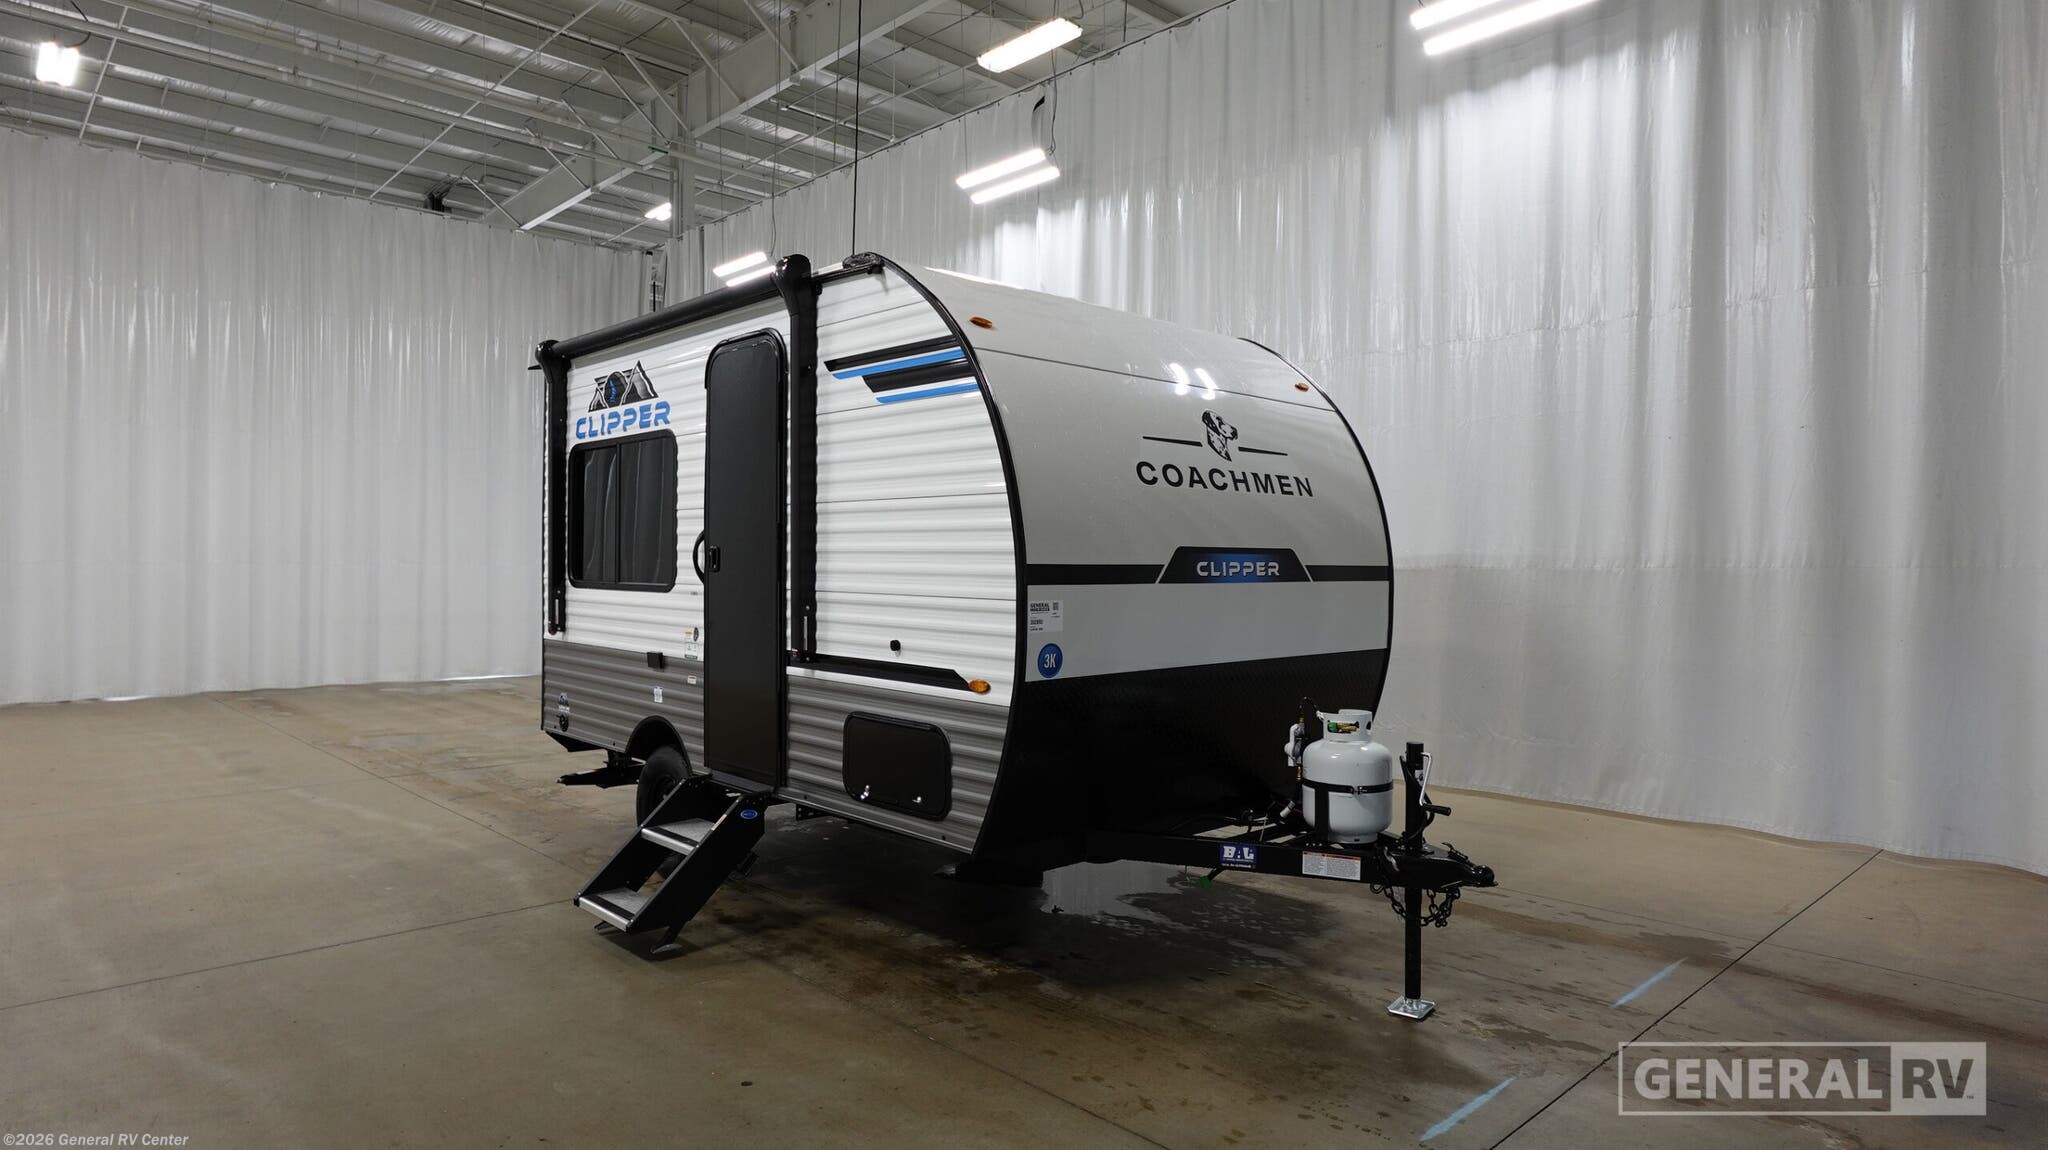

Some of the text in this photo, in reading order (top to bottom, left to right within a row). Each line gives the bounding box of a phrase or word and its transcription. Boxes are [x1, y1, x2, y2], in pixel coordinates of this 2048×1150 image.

[576, 401, 670, 439] CLIPPER
[1136, 461, 1313, 497] COACHMEN
[1196, 561, 1280, 577] CLIPPER
[1043, 653, 1056, 668] 3K
